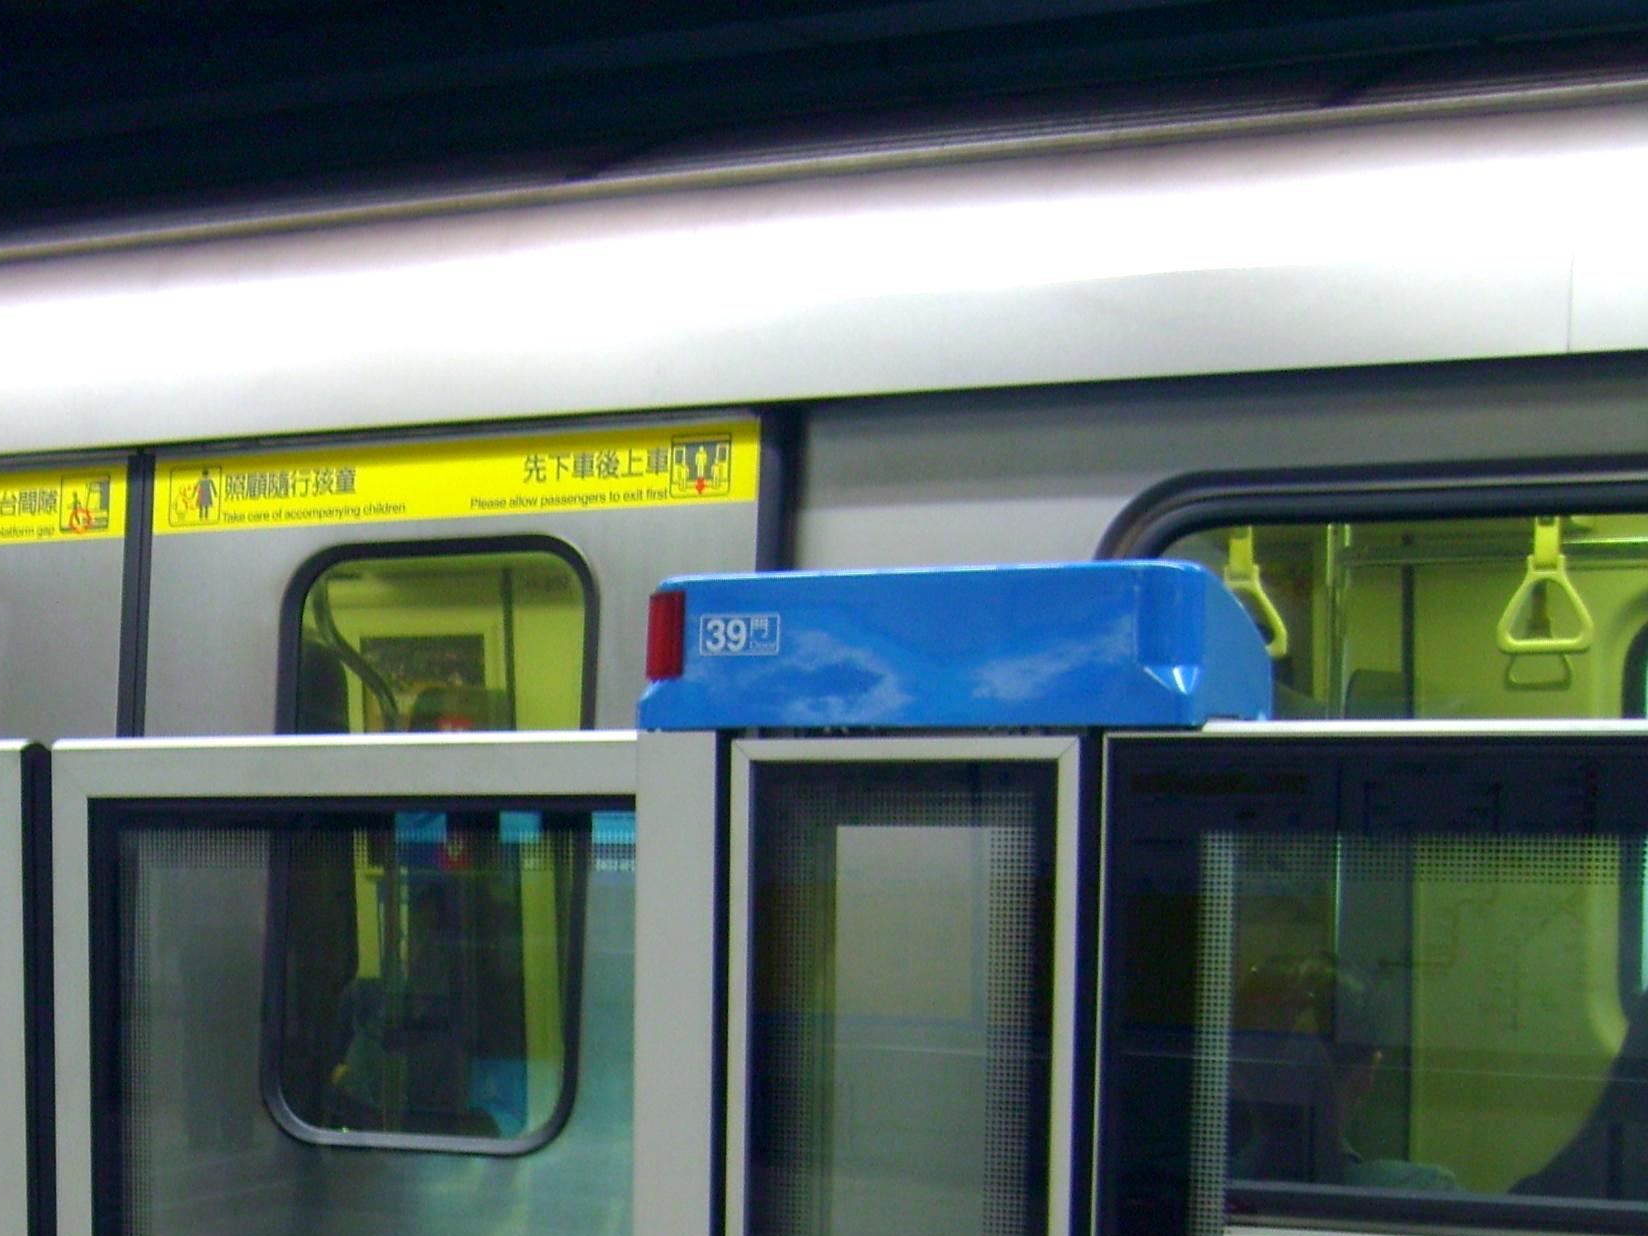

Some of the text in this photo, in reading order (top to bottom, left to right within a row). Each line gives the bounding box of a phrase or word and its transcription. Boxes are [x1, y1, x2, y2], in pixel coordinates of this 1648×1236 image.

[524, 448, 669, 483] 先下車後上車
[225, 467, 356, 501] 照顧隨行孩童
[470, 487, 668, 509] Please allow passengers to exit first
[222, 502, 406, 522] Take care of accompanying children
[705, 618, 747, 653] 39
